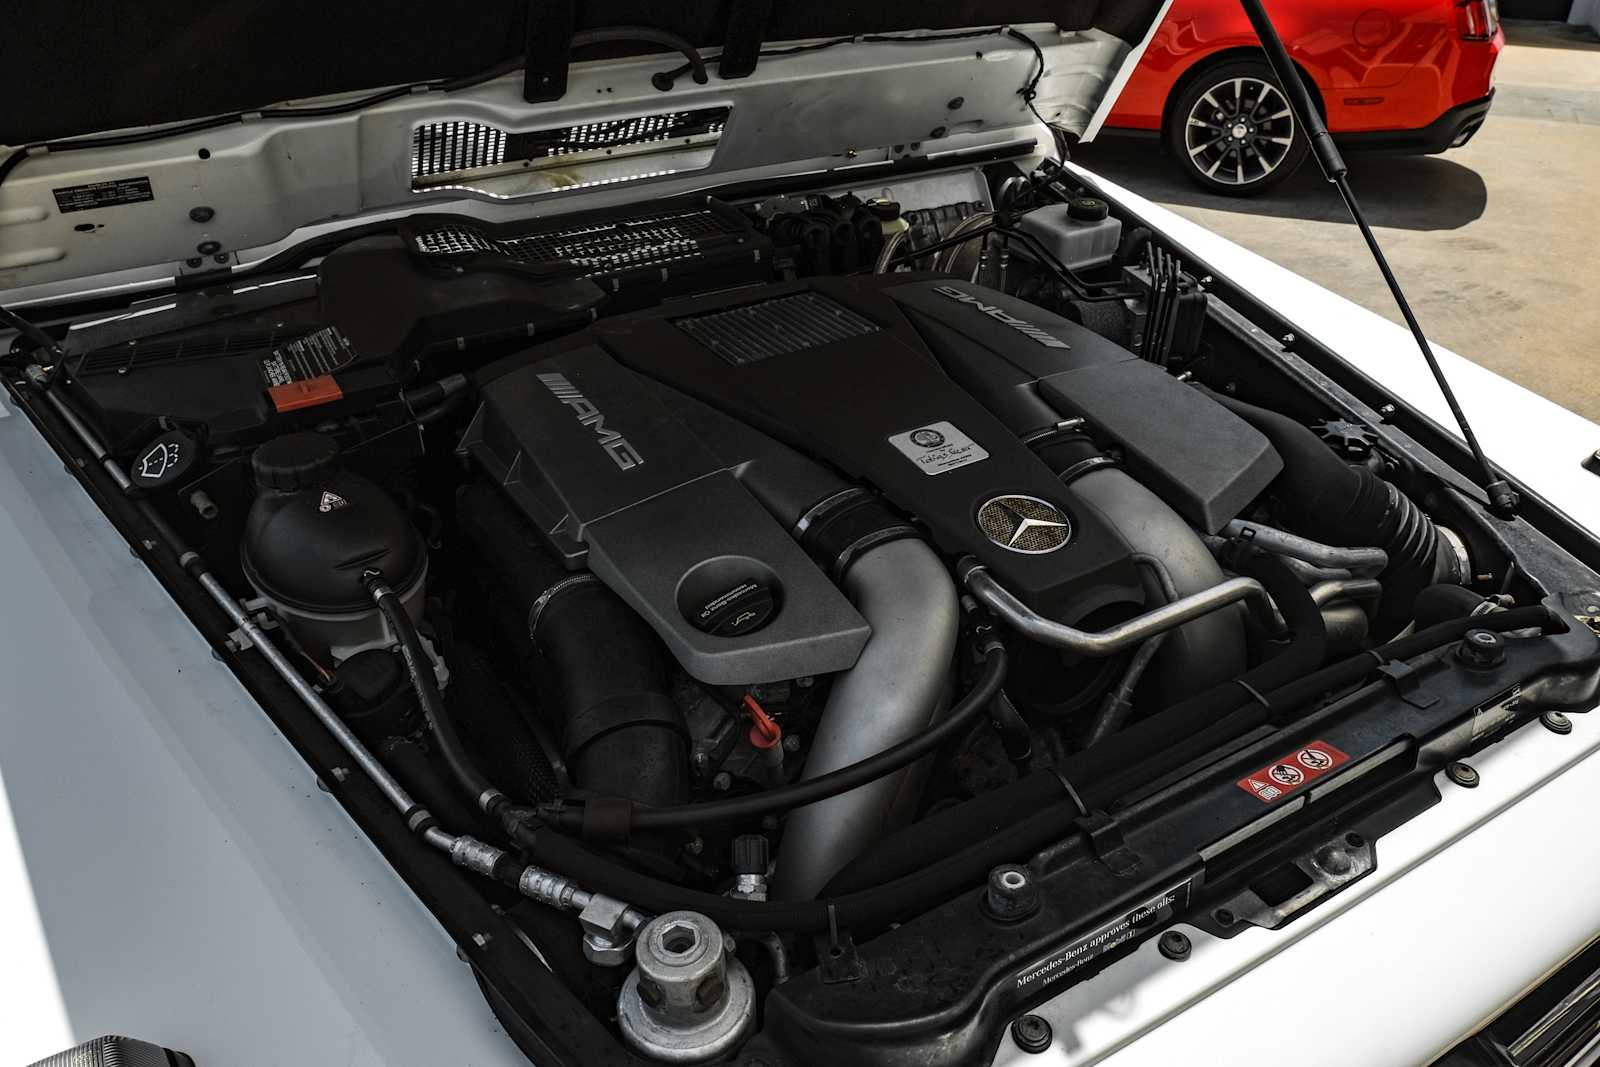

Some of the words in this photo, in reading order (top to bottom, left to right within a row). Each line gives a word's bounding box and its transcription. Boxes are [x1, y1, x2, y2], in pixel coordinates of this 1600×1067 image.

[560, 398, 644, 471] AMG
[1016, 943, 1088, 989] Mercedes-Benz
[1089, 920, 1130, 951] approves
[1132, 906, 1156, 925] these
[1157, 894, 1176, 910] oils:
[1042, 954, 1095, 987] Mercedes-Benz
